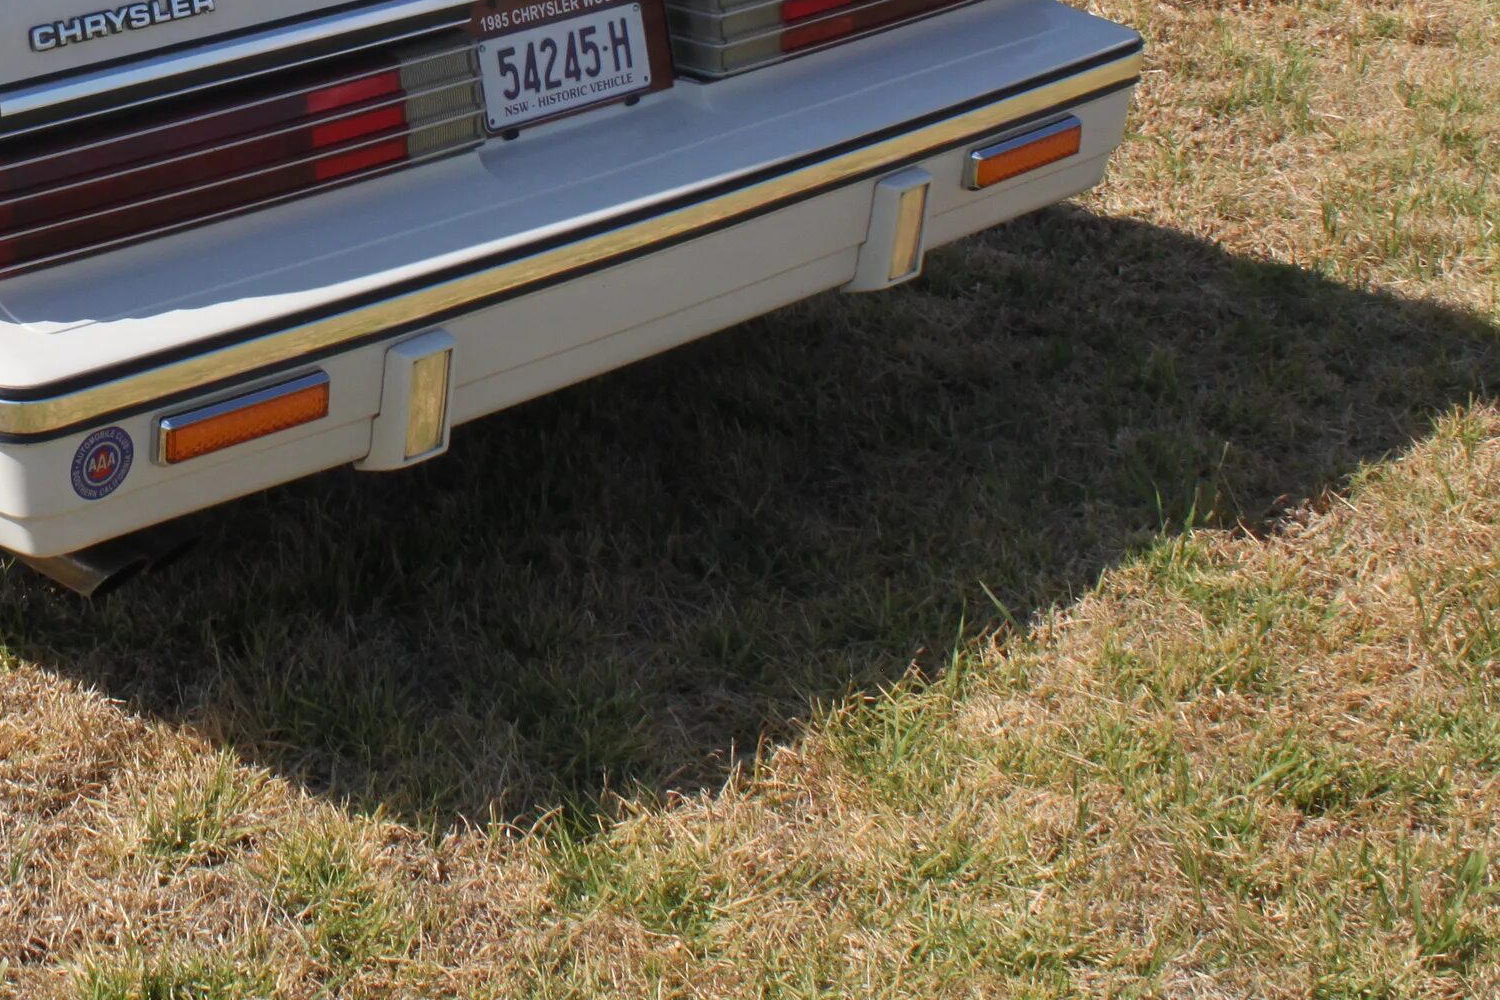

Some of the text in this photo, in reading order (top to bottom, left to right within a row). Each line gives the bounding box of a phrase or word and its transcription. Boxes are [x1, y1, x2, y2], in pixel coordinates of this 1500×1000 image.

[480, 11, 509, 32] 1985
[504, 100, 529, 117] NSW
[538, 84, 588, 109] HISTORIC
[590, 72, 634, 96] VEHICLE
[87, 451, 116, 473] AAA
